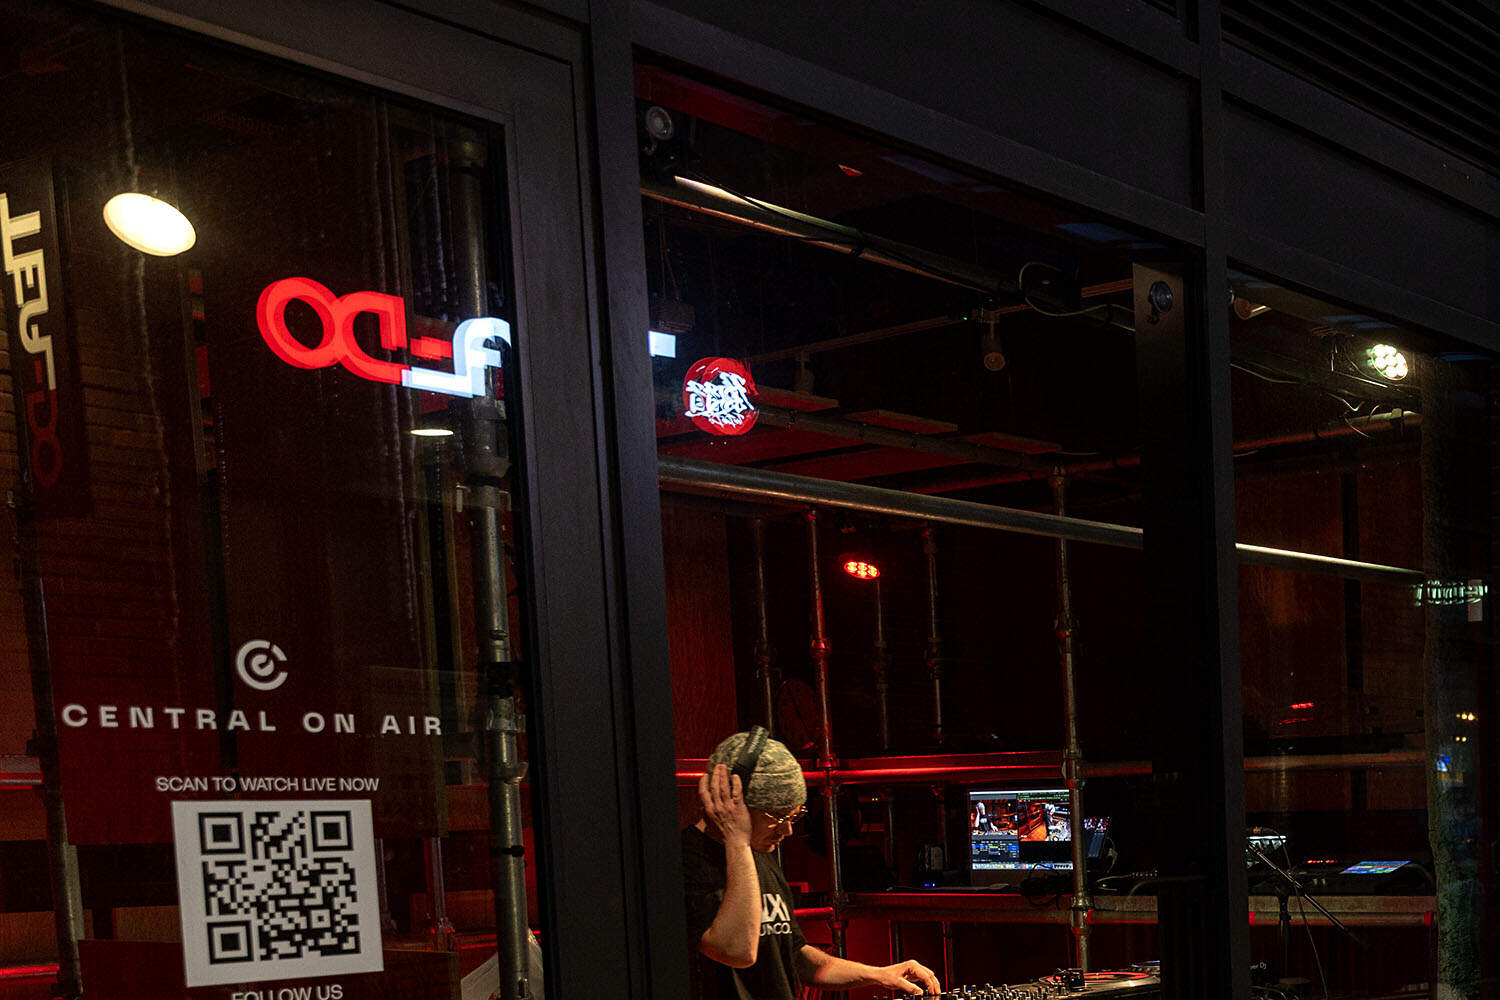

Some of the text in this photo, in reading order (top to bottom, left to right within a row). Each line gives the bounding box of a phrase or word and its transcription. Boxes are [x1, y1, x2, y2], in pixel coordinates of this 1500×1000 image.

[62, 704, 443, 736] CENTRAL ON AIR
[156, 776, 380, 793] SCAN TO WATCH LIVE NOW
